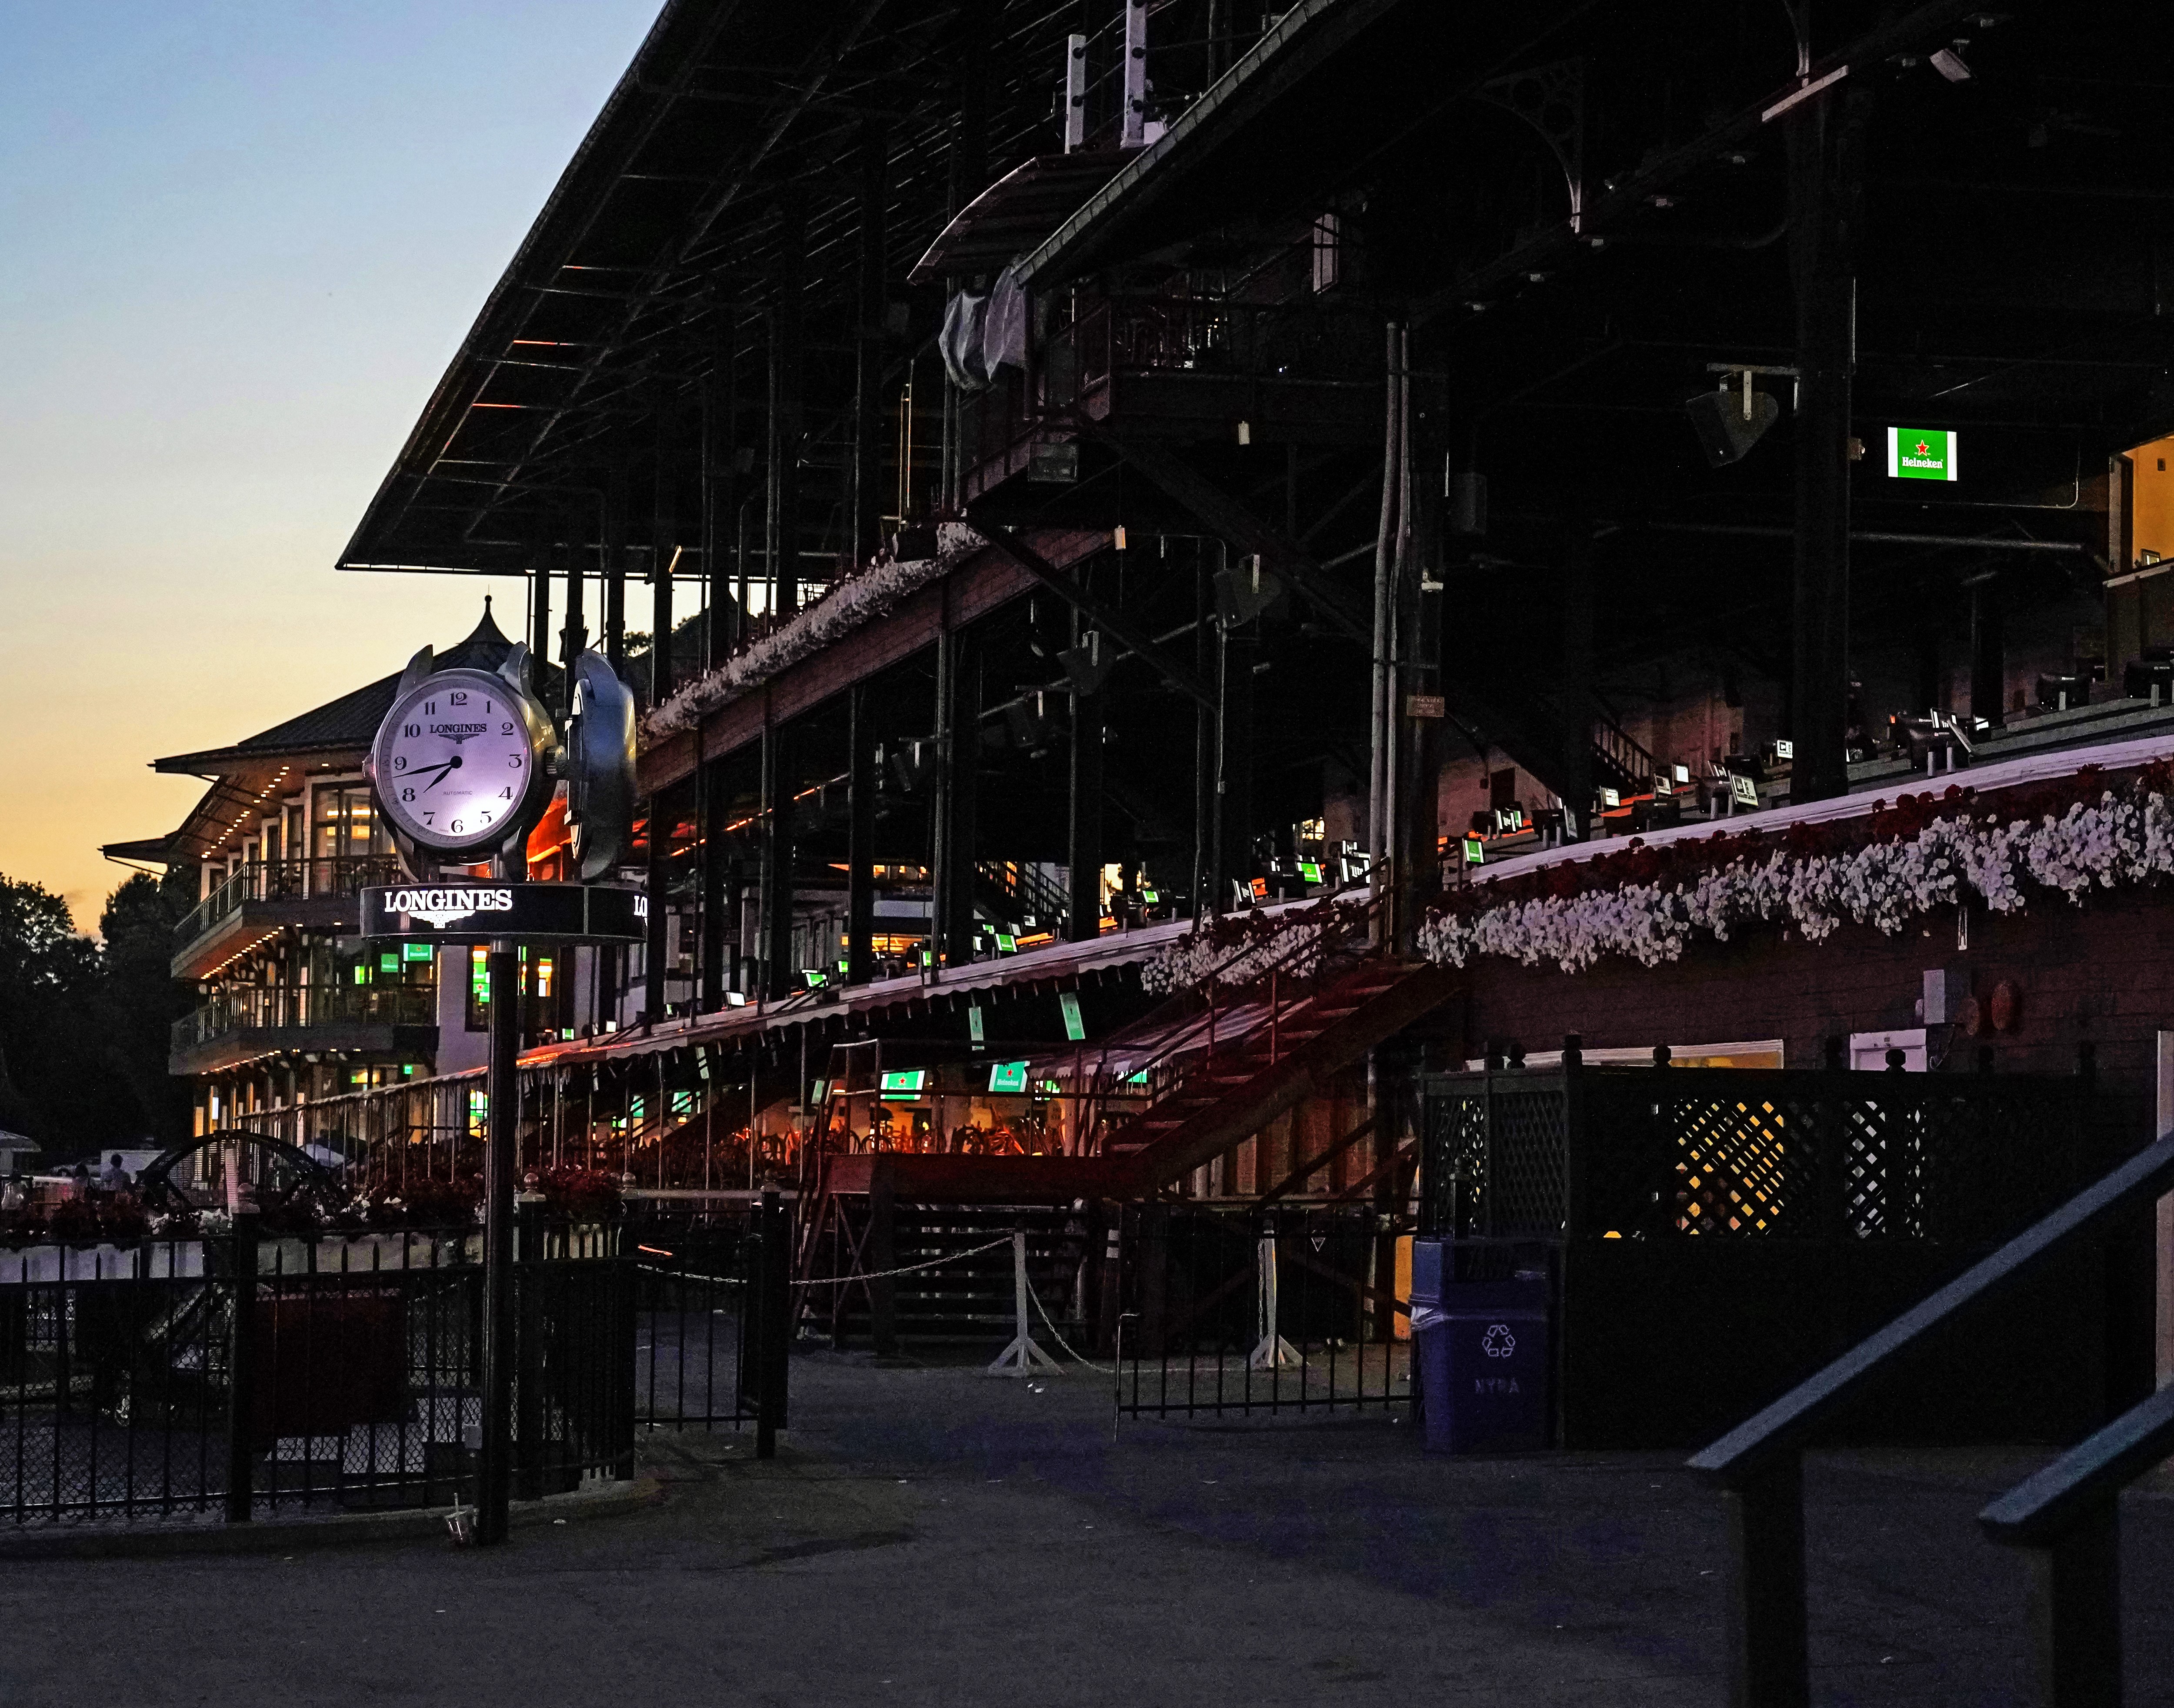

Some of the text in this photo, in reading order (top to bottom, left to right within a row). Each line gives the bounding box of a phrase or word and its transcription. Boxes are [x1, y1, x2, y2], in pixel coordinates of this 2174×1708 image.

[1902, 457, 1943, 469] Heineken
[450, 692, 467, 706] 12
[425, 701, 436, 715] 11
[486, 701, 490, 714] 1
[404, 723, 421, 738] 10
[430, 723, 487, 734] LONGINES
[501, 722, 514, 736] 2
[394, 756, 407, 771] 9
[508, 754, 522, 768] 3
[402, 787, 416, 802] 8
[498, 786, 513, 800] 4
[423, 811, 436, 825] 7
[480, 811, 492, 824] 5
[451, 819, 463, 833] 6
[385, 889, 513, 912] LONGINES
[634, 895, 648, 917] LO
